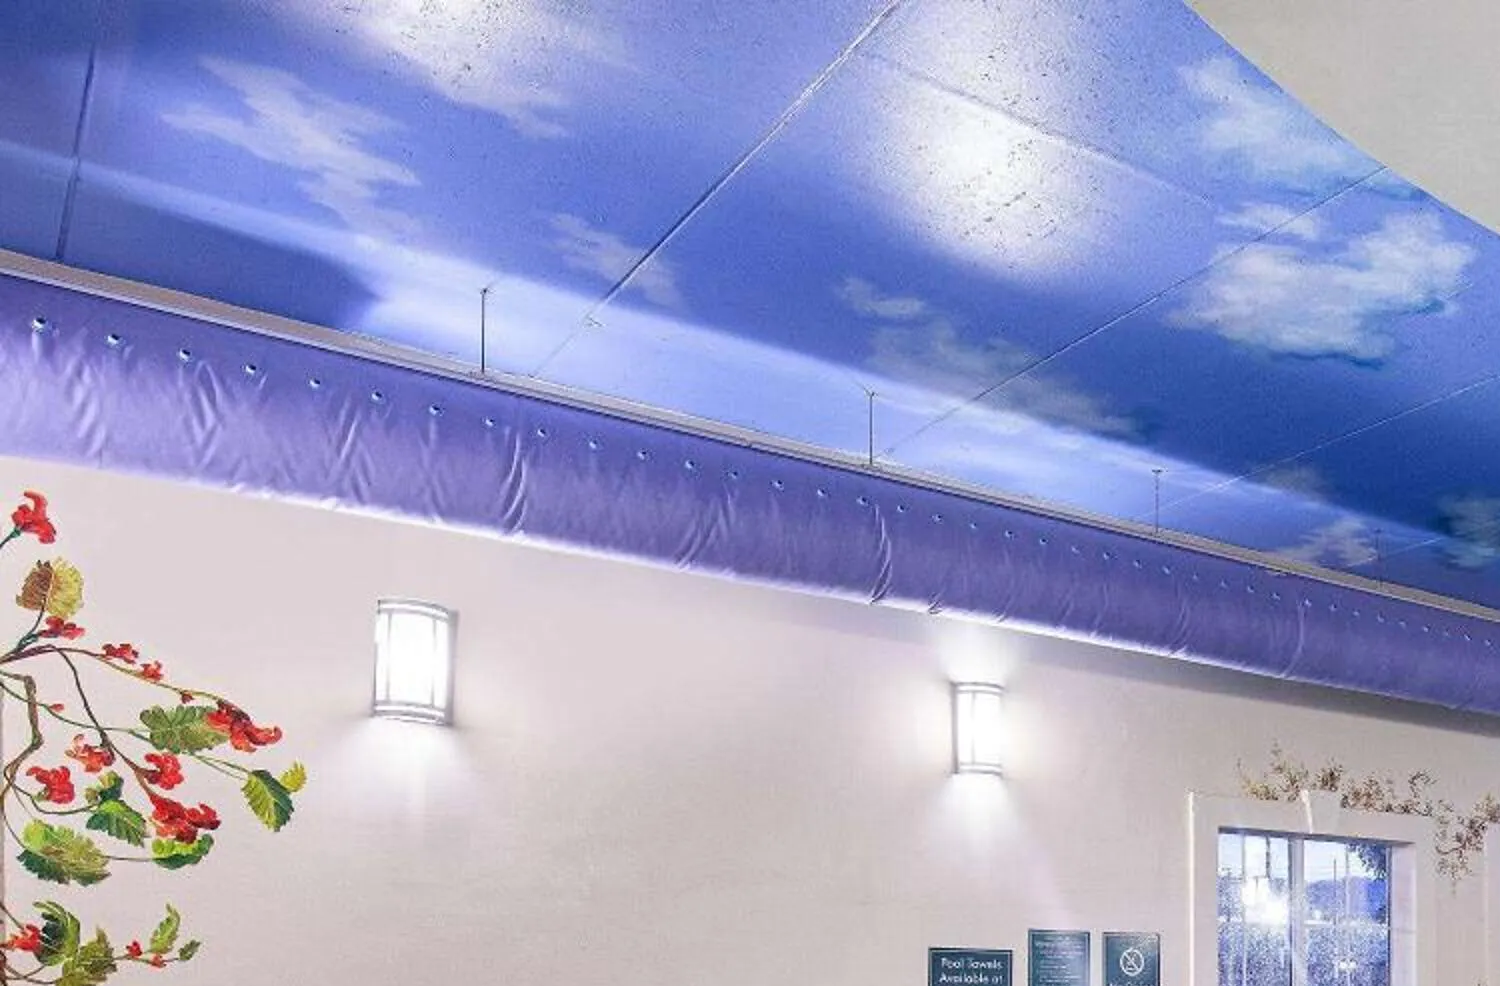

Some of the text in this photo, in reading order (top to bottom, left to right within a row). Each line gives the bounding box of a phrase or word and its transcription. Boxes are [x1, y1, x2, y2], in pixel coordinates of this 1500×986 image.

[941, 957, 1003, 969] Pool Towels
[939, 972, 989, 984] Available
